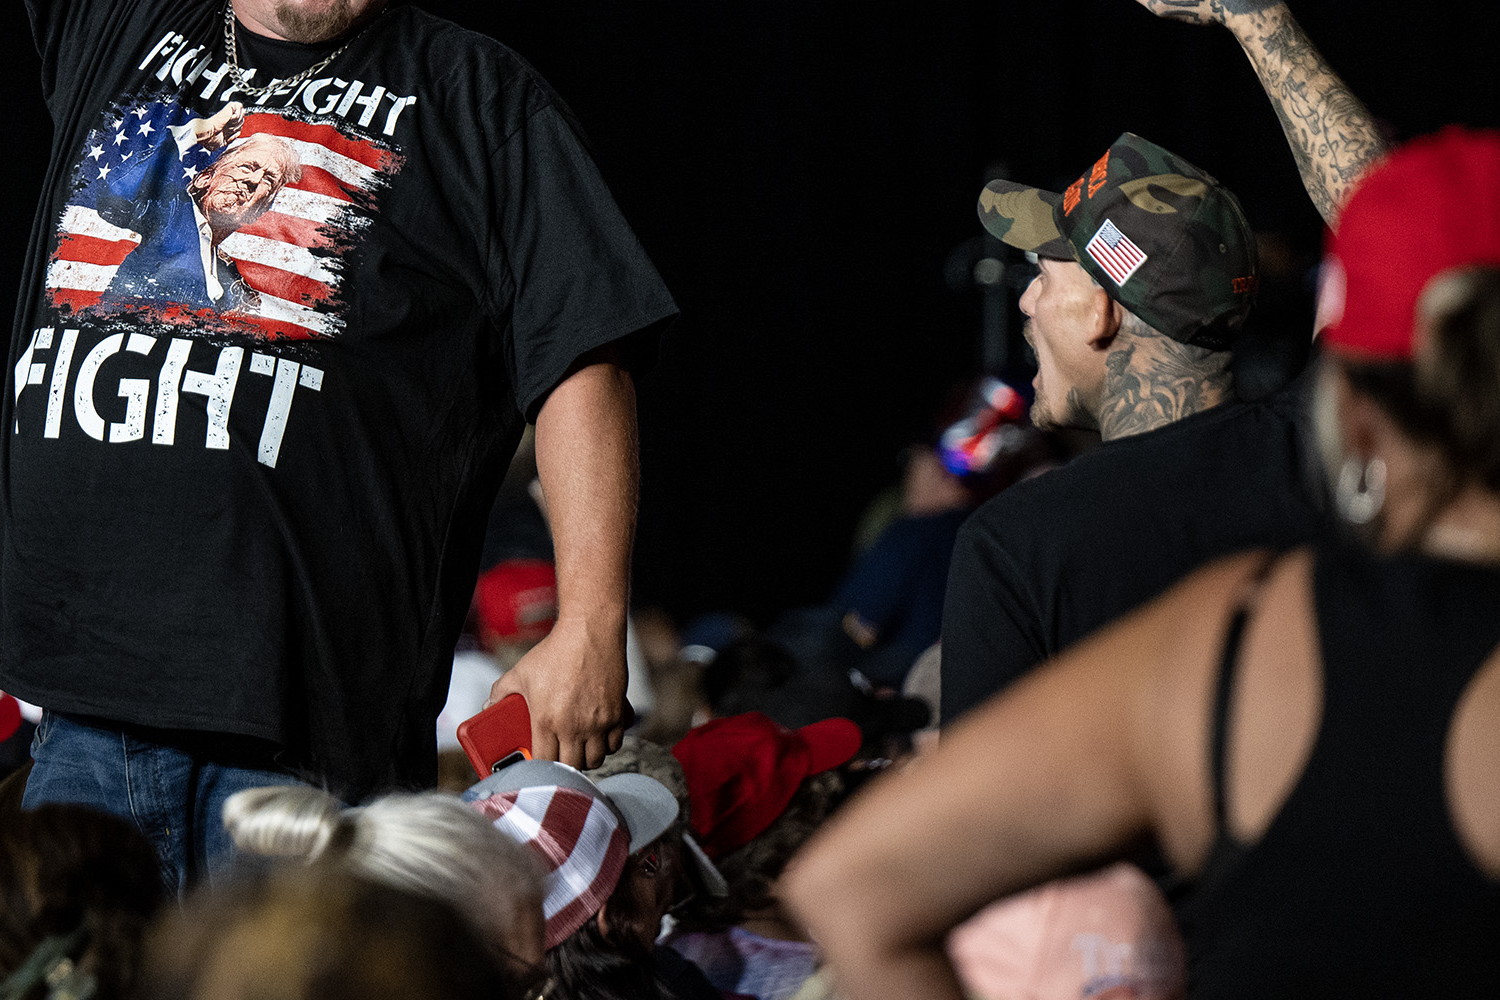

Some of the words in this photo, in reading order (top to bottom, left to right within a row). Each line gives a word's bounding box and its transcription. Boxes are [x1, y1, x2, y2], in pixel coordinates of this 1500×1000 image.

[138, 30, 258, 103] FIGHT
[254, 76, 418, 137] FIGHT
[14, 326, 325, 469] FIGHT
